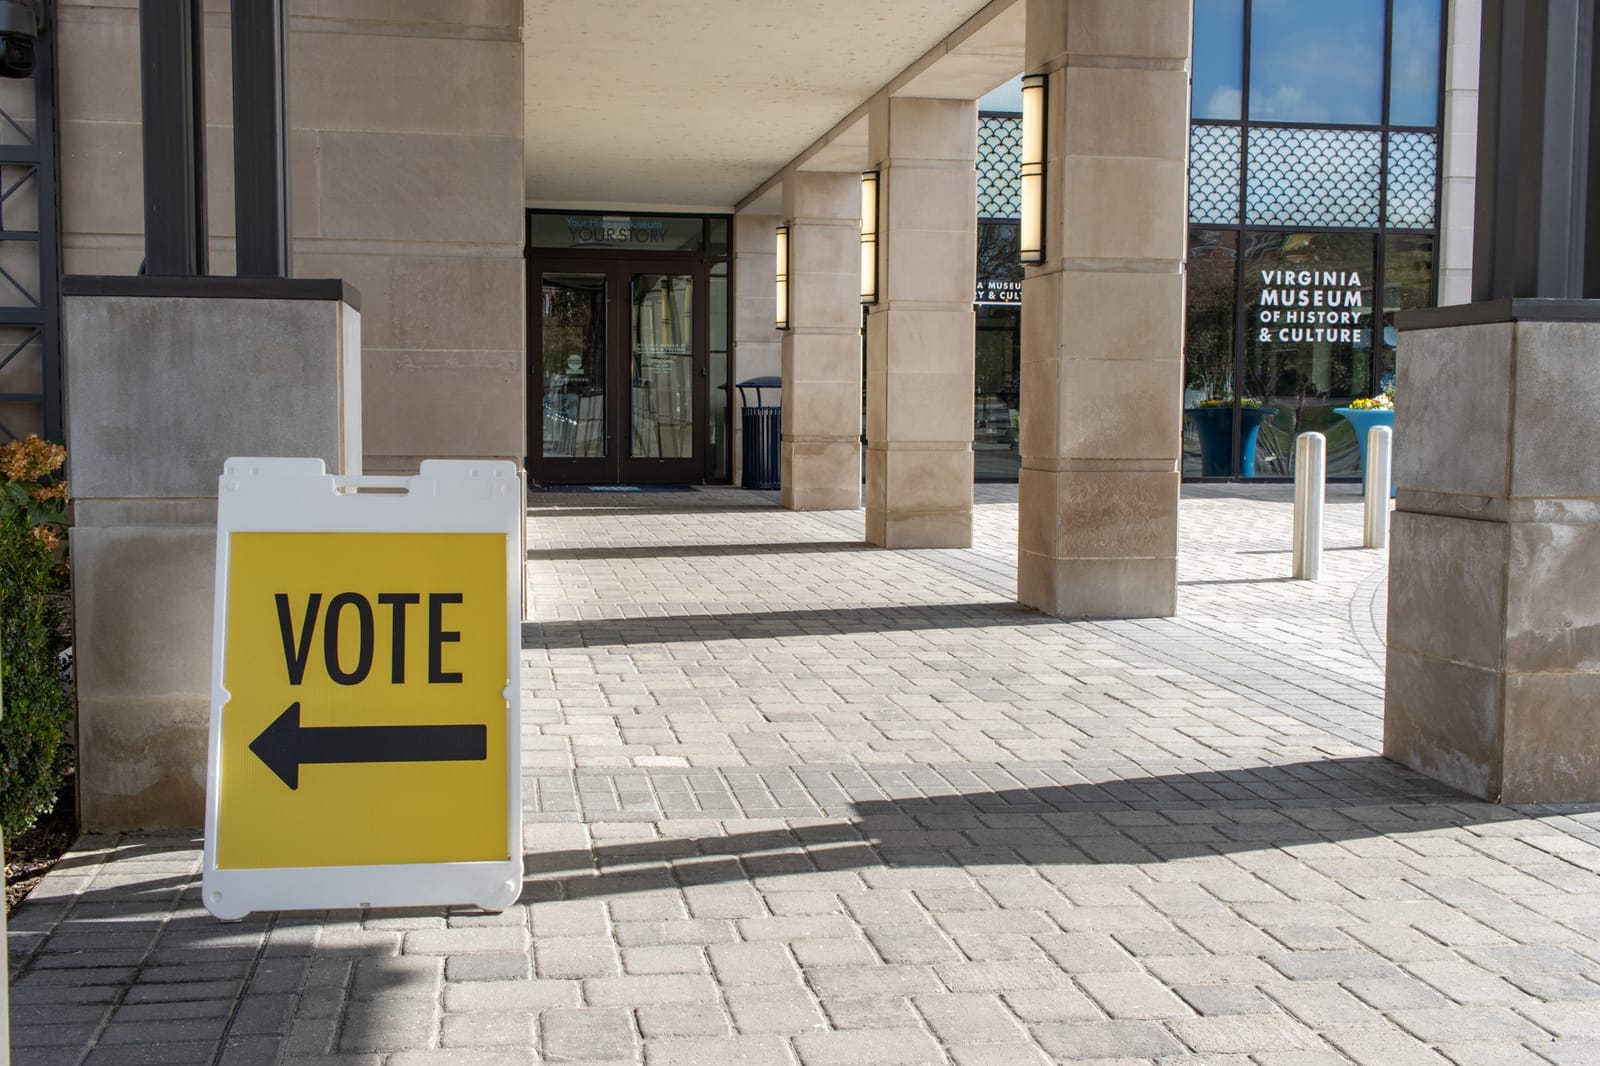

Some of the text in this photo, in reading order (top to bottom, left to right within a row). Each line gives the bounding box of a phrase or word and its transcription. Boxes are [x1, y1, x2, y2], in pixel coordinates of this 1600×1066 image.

[1261, 270, 1361, 286] VIRGINIA
[988, 291, 996, 300] &
[999, 291, 1022, 300] CUL
[1260, 289, 1362, 307] MUSEUM
[1260, 311, 1361, 323] OF HISTORY
[1259, 327, 1361, 343] & CULTURE
[275, 592, 464, 686] VOTE
